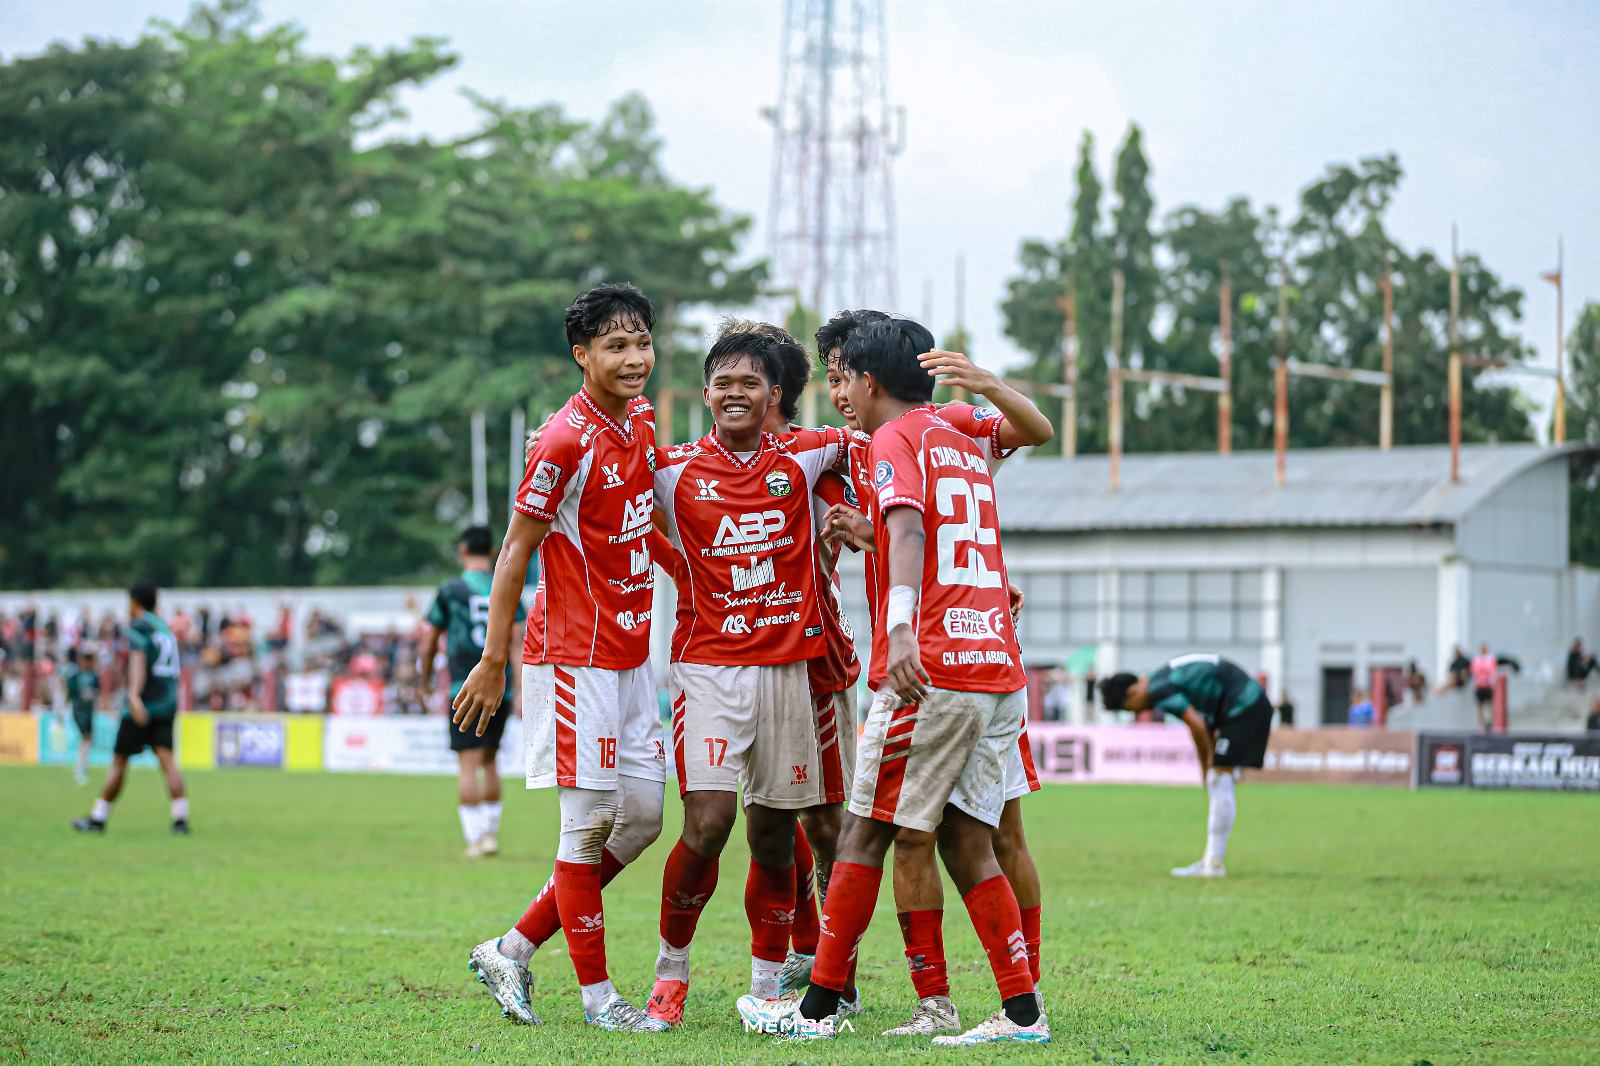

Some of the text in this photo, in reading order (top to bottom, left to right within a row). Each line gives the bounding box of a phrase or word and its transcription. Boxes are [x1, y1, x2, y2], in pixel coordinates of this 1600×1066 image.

[712, 509, 786, 547] ABP
[701, 548, 711, 558] PT.
[949, 610, 984, 623] GARDA
[950, 621, 988, 635] EMAS
[942, 651, 957, 666] CV.
[958, 650, 985, 665] HASTA
[597, 737, 617, 769] 18
[704, 737, 729, 767] 17
